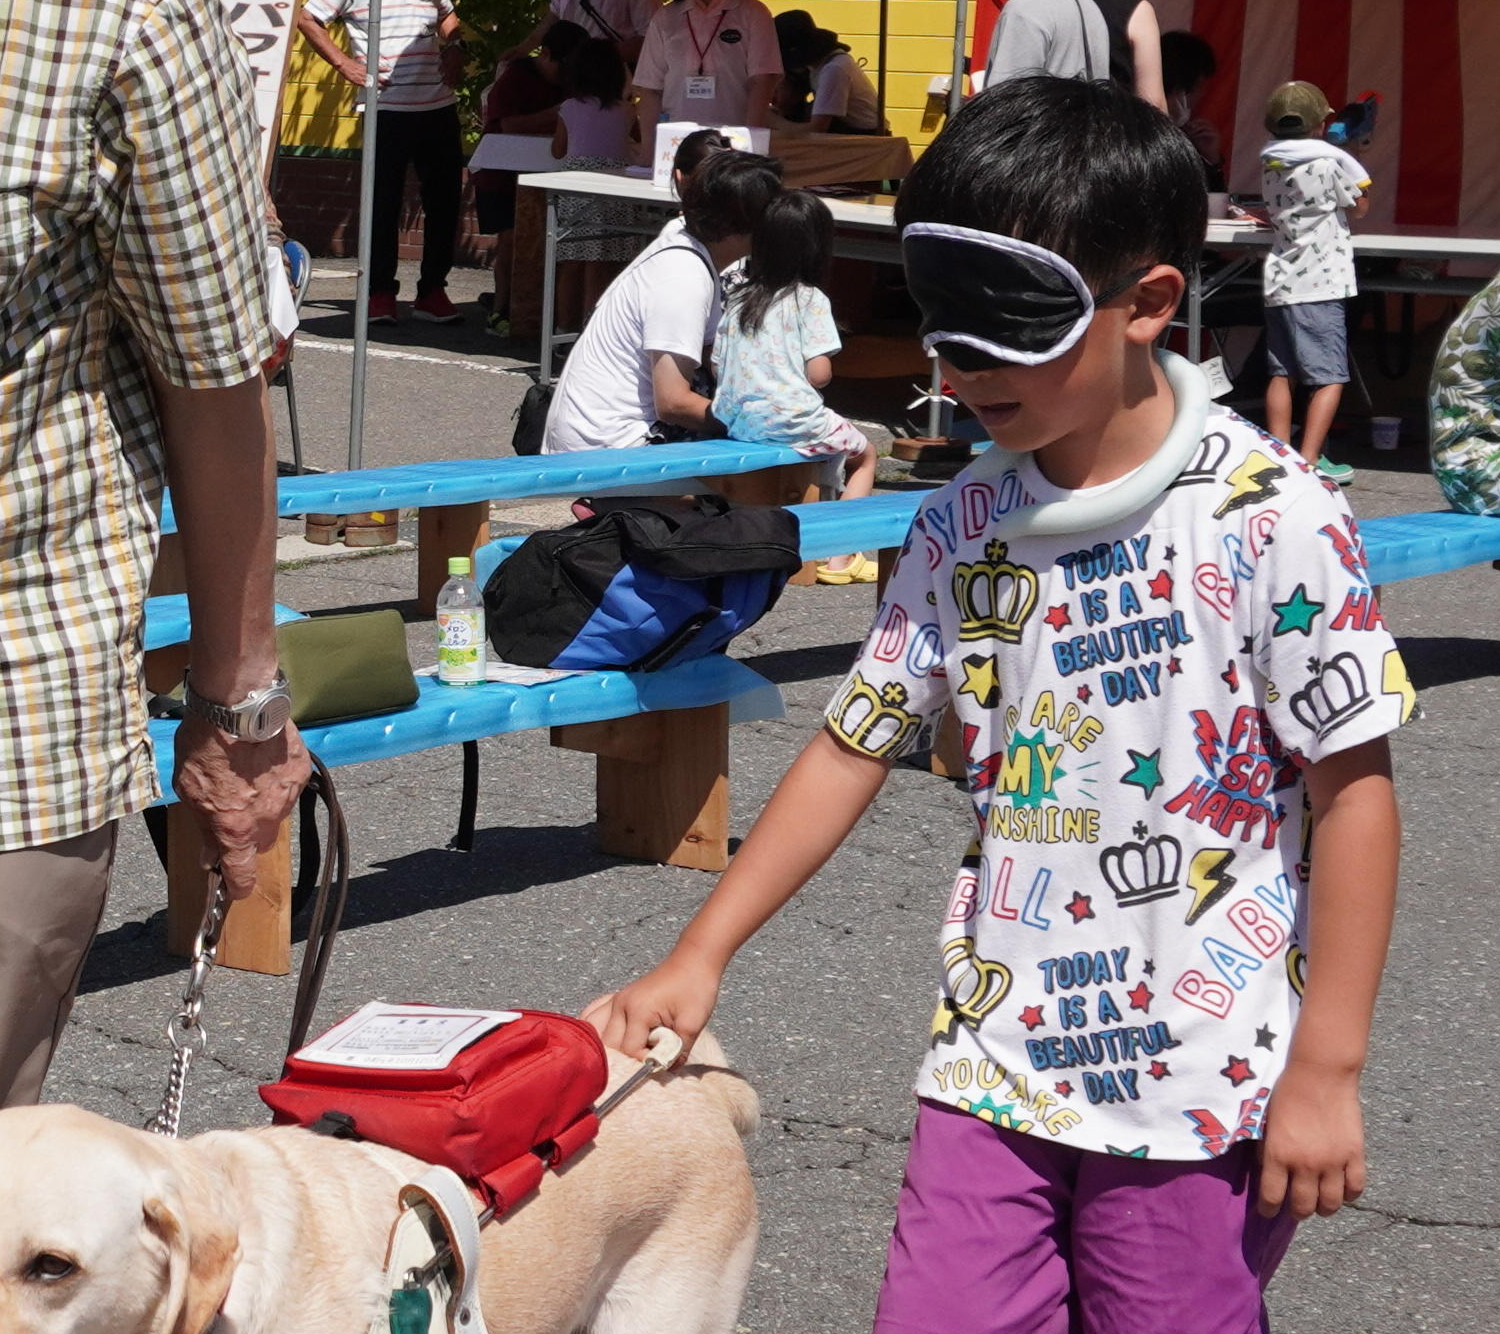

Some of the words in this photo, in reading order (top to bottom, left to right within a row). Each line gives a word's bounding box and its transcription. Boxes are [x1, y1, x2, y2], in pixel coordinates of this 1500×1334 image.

[1055, 534, 1151, 591] TODAY
[1080, 589, 1108, 627] IS
[1119, 581, 1143, 617] A
[1052, 610, 1194, 677] BEAUTIFUL
[1100, 661, 1161, 708] DAY
[1031, 690, 1105, 753] ARE
[996, 743, 1065, 796] MY
[1219, 752, 1273, 799] SO
[986, 805, 1102, 844] NSHINE
[1163, 774, 1287, 850] HAPPY
[1038, 946, 1130, 994] TODAY
[1172, 872, 1297, 1020] BABY
[1058, 995, 1088, 1030] IS
[1098, 990, 1123, 1025] A
[1025, 1021, 1182, 1072] BEAUTIFUL
[932, 1058, 1006, 1093] YOU
[1005, 1074, 1083, 1137] ARE
[1082, 1068, 1140, 1105] DAY
